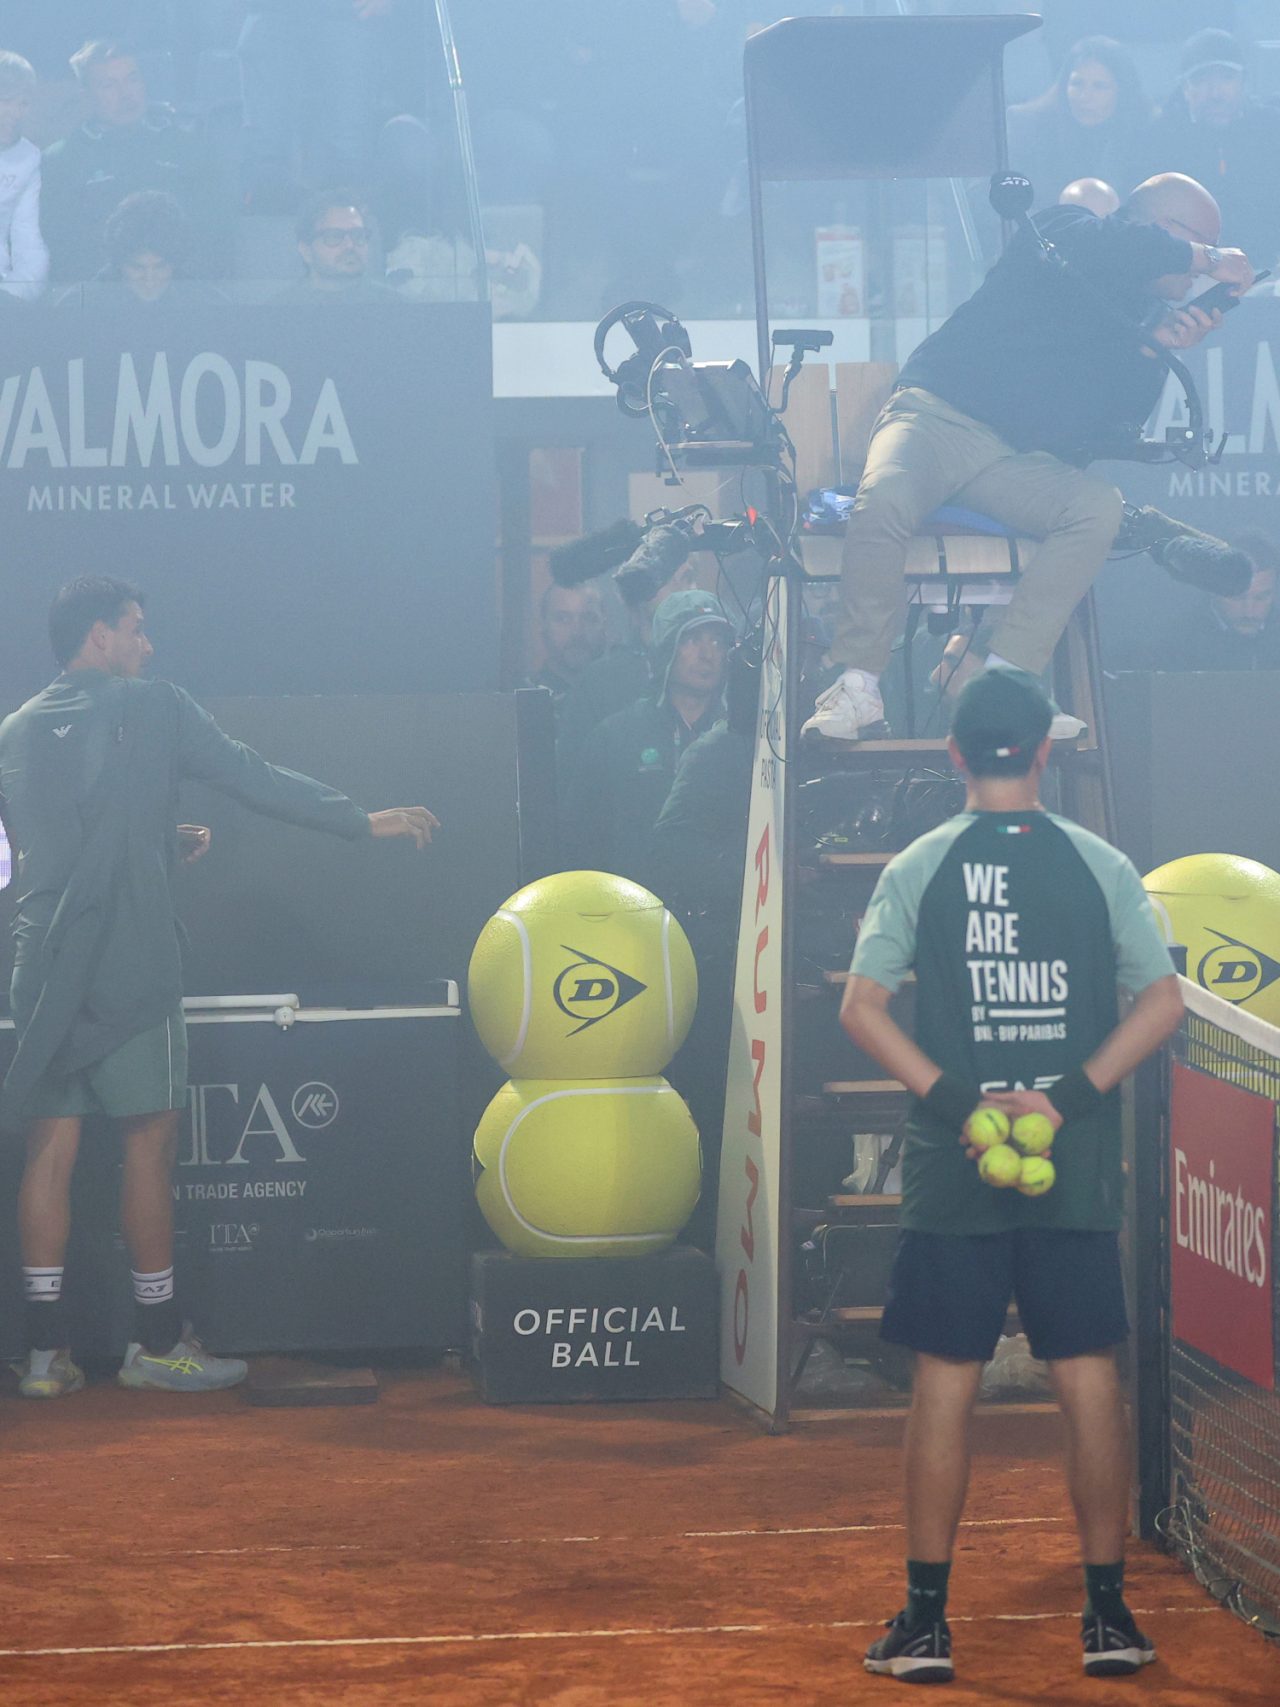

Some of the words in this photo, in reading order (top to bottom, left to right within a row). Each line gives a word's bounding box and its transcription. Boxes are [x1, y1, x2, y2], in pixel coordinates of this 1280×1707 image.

[27, 484, 176, 512] MINERAL
[187, 483, 297, 509] WATER
[962, 862, 1009, 907] WE
[965, 910, 1019, 954] ARE
[966, 959, 1068, 1002] TENNIS
[734, 822, 770, 1366] RUMMO
[179, 1082, 308, 1167] TA
[185, 1183, 239, 1200] TRADE
[243, 1180, 308, 1199] AGENCY
[208, 1224, 252, 1244] ITA
[1174, 1147, 1267, 1289] Emirates
[513, 1305, 687, 1336] OFFICIAL
[551, 1340, 640, 1368] BALL
